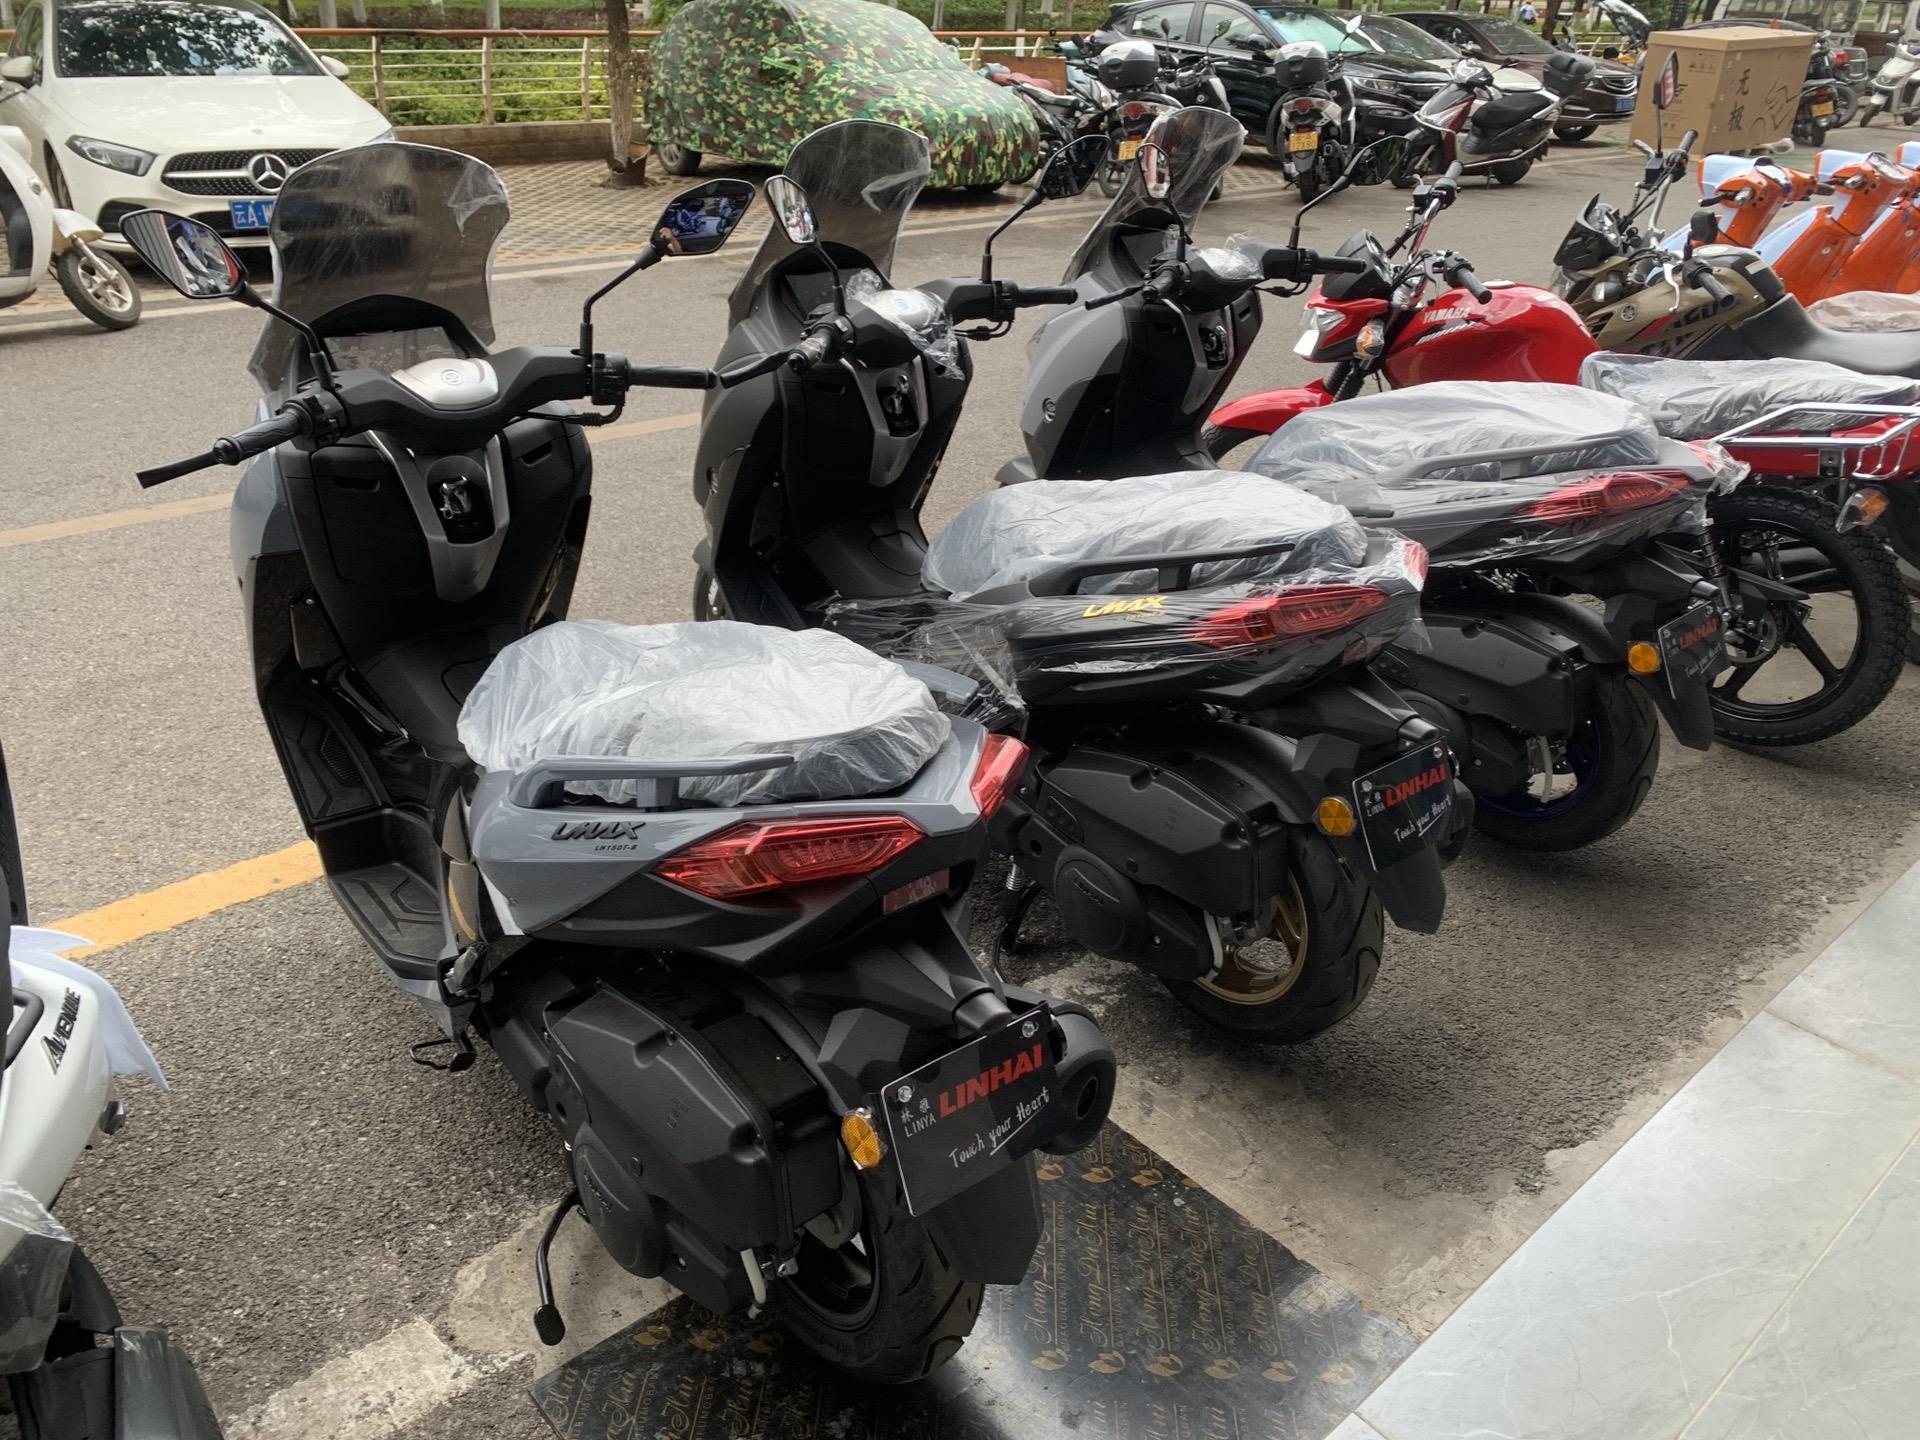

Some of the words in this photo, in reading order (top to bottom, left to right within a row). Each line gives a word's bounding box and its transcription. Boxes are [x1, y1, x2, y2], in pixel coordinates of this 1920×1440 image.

[1422, 306, 1472, 325] YAMAHA
[1385, 762, 1447, 808] LINHAI
[938, 1043, 1044, 1119] LINHAI
[904, 1113, 937, 1139] LINYA
[948, 1133, 985, 1169] Touch
[988, 1117, 1012, 1148] your
[1016, 1086, 1050, 1123] Heart
